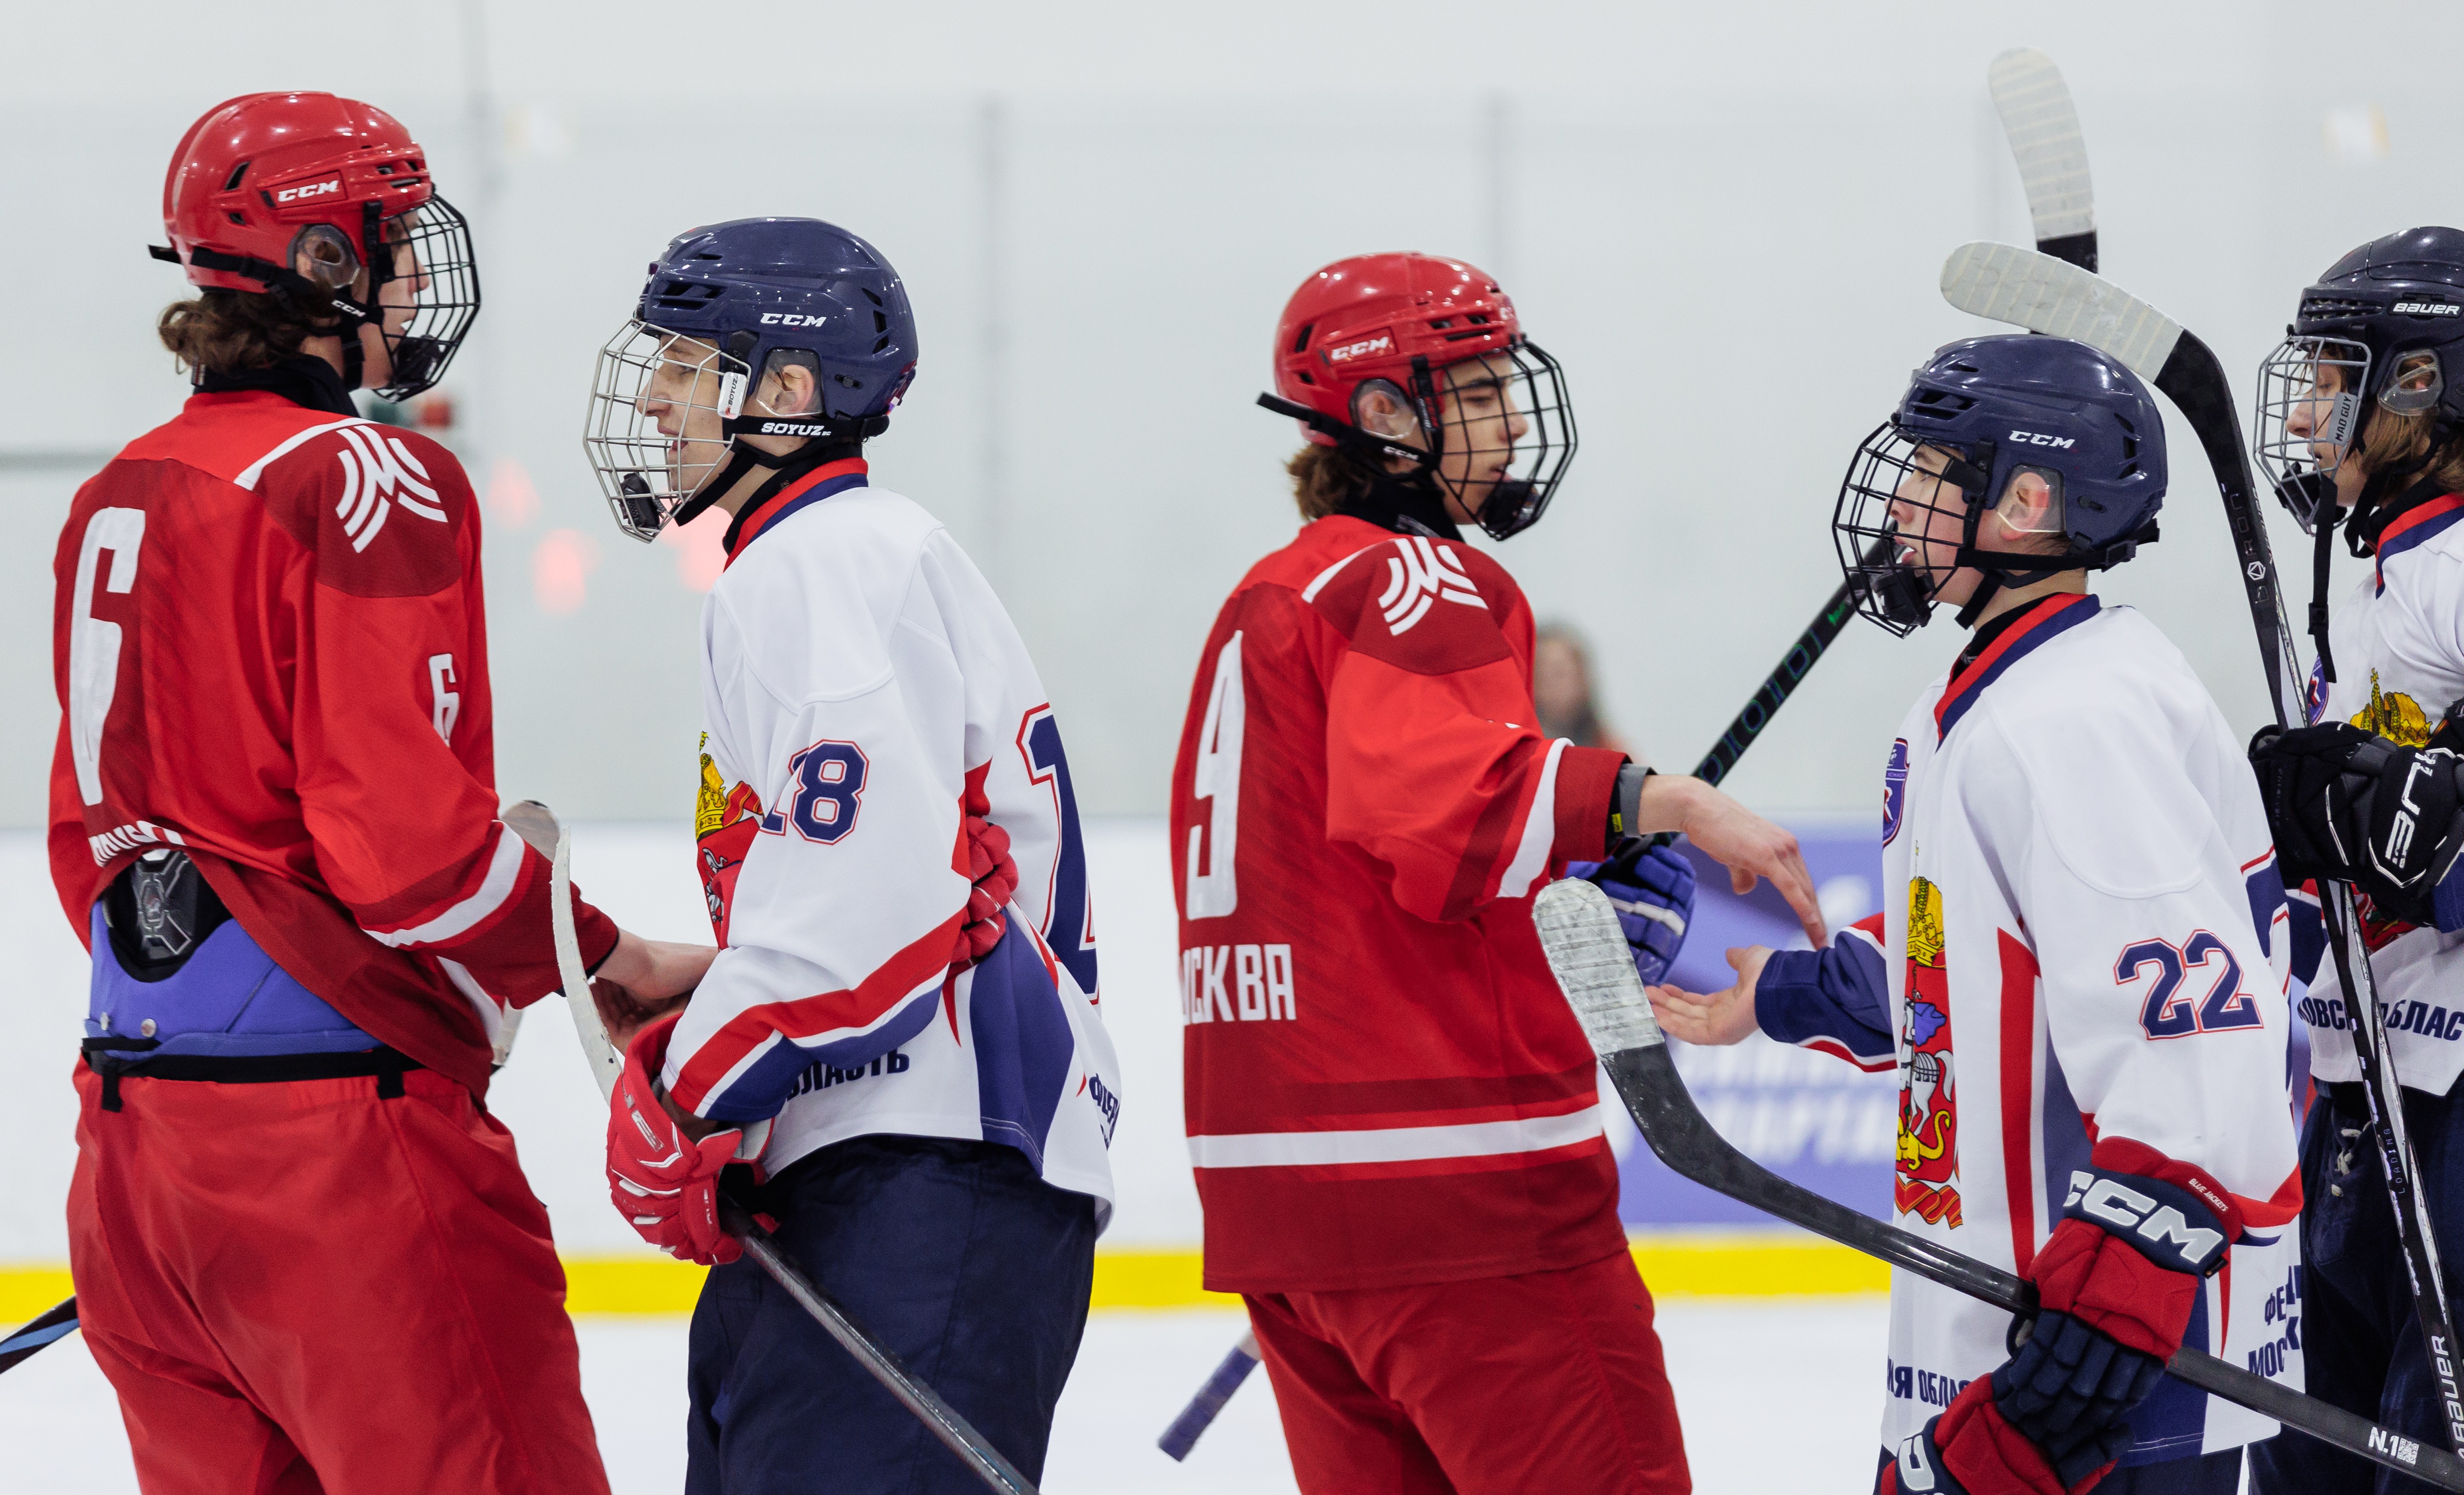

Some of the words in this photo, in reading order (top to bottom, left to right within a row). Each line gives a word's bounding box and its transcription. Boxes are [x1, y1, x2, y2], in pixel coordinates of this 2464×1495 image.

[278, 180, 339, 202] CCM
[760, 313, 827, 327] CCM
[2392, 303, 2460, 315] BAUER
[1331, 336, 1390, 361] CCM
[728, 378, 739, 406] SOYUZ
[761, 422, 825, 436] SOYUZ
[2334, 419, 2347, 441] MAD
[2341, 396, 2352, 418] GUY
[2009, 430, 2075, 449] CCM
[69, 506, 146, 806] 6
[428, 653, 460, 748] 6
[1186, 630, 1245, 921] 9
[2113, 928, 2264, 1041] 22
[2188, 1178, 2207, 1193] BLUE
[2204, 1191, 2229, 1212] JACKETS
